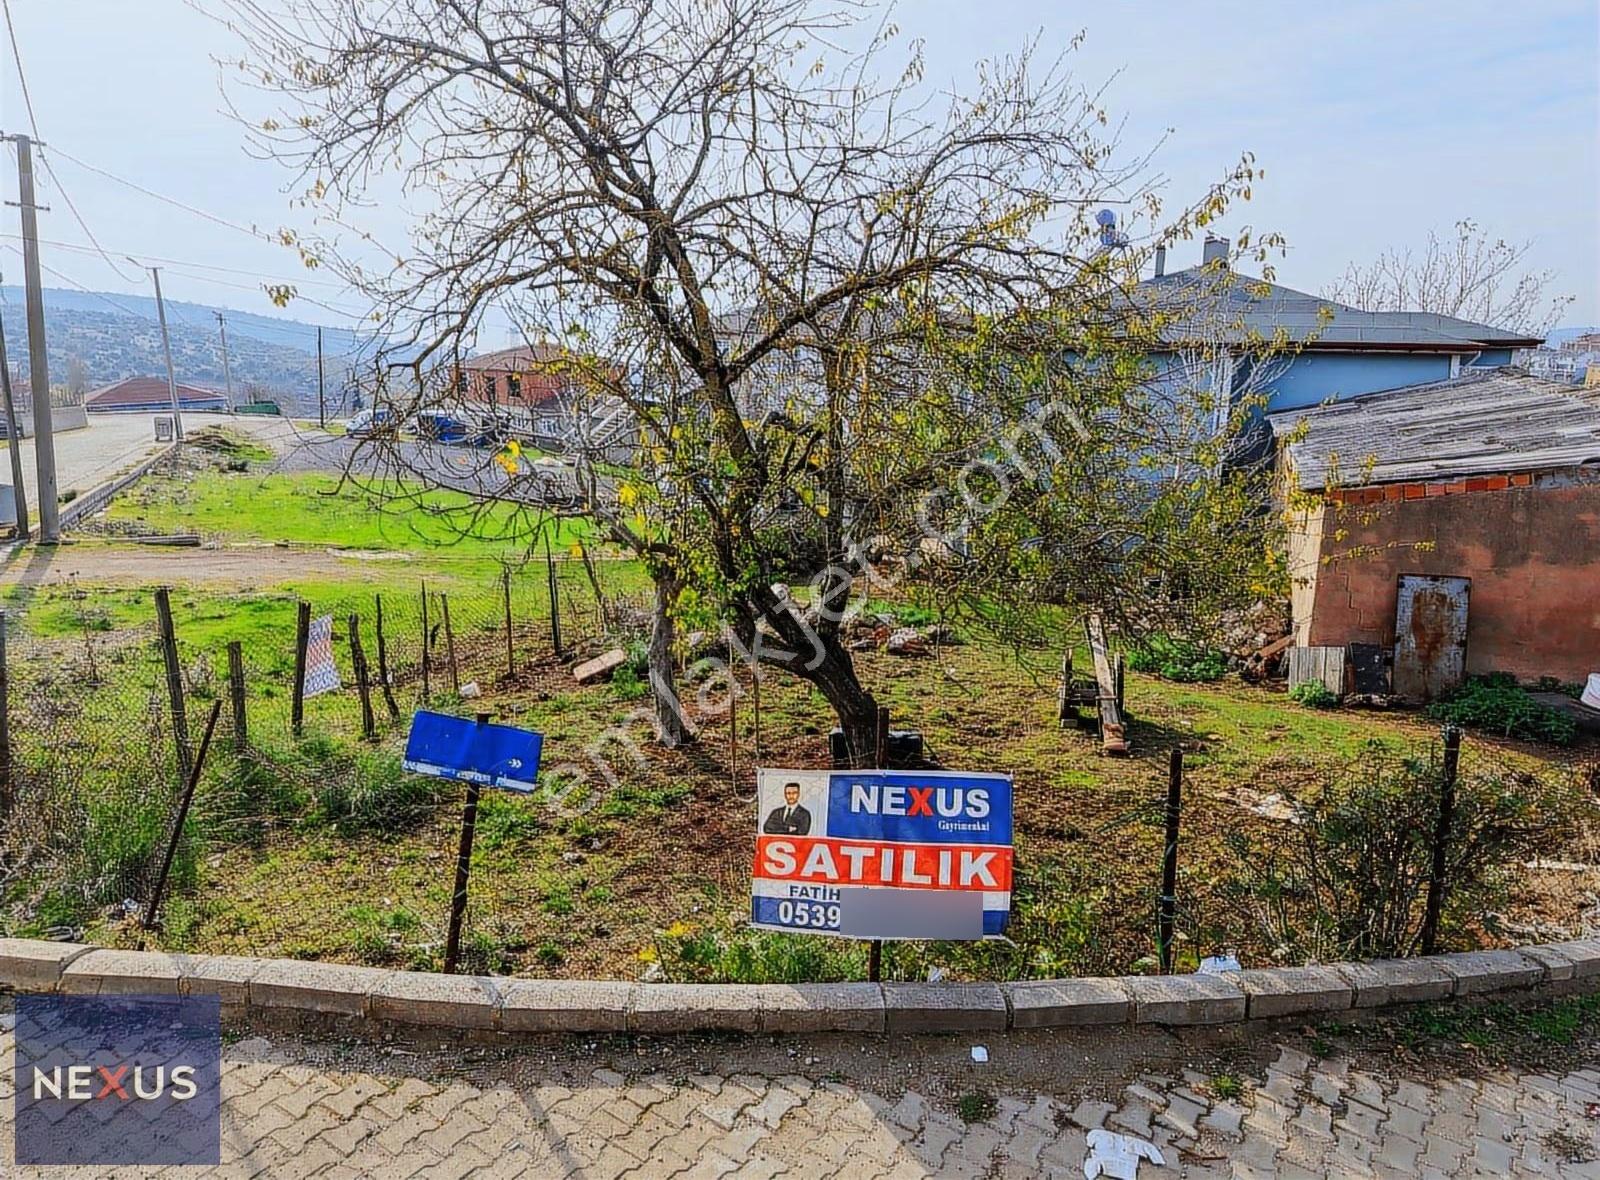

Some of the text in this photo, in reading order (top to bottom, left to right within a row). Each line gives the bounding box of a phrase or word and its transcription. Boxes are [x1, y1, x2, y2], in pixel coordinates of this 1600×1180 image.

[851, 785, 990, 818] NEXUS
[763, 841, 998, 887] SATILIK
[789, 884, 840, 901] FATİH
[778, 900, 840, 928] 0539
